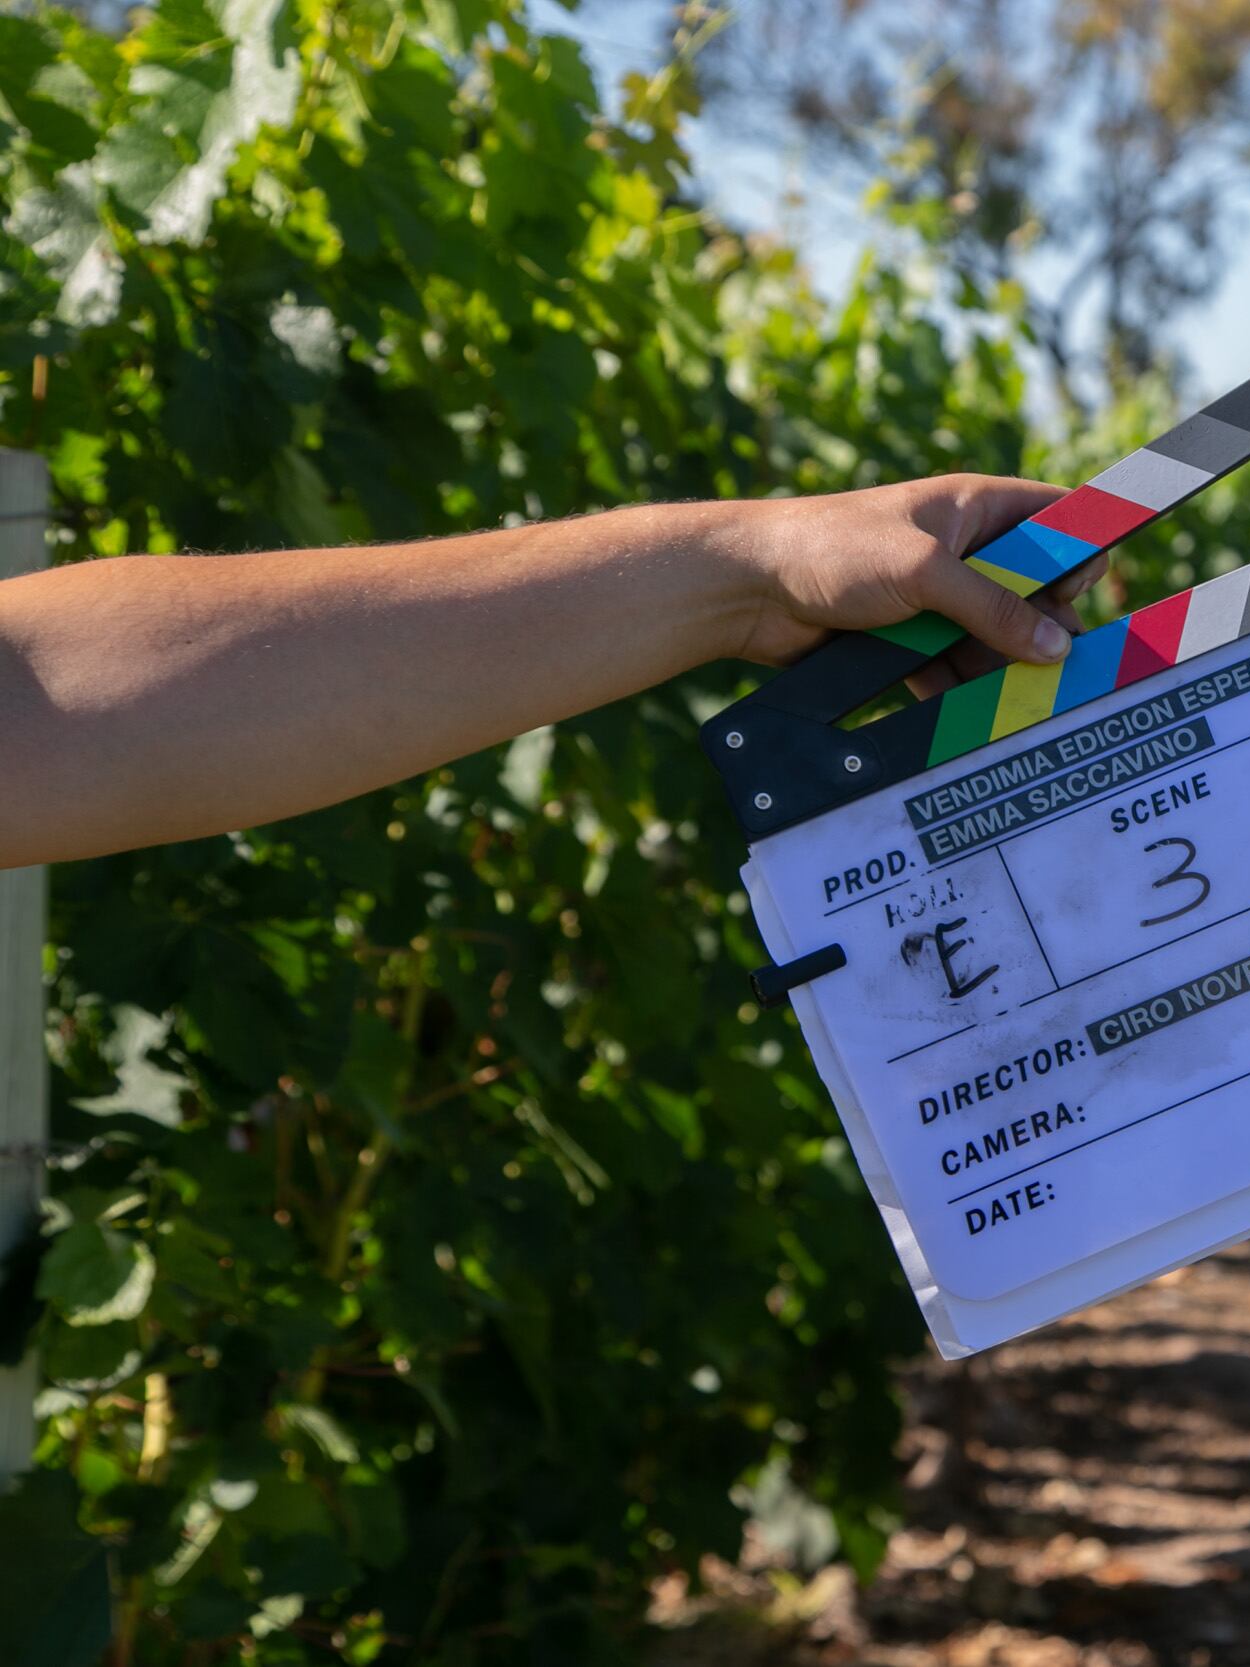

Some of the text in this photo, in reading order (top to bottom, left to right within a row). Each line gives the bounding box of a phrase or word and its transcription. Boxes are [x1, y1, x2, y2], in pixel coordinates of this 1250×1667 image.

[912, 746, 1054, 822] VENDIMIA
[1060, 697, 1175, 763] EDICION
[931, 727, 1198, 856] EMMA SACCAVINO
[1111, 772, 1212, 833] SCENE
[822, 850, 917, 903] PROD.
[1139, 837, 1211, 928] 3
[919, 1038, 1088, 1125] DIRECTOR:
[1098, 997, 1174, 1047] CIRO
[940, 1102, 1087, 1176] CAMERA:
[965, 1180, 1056, 1236] DATE:
